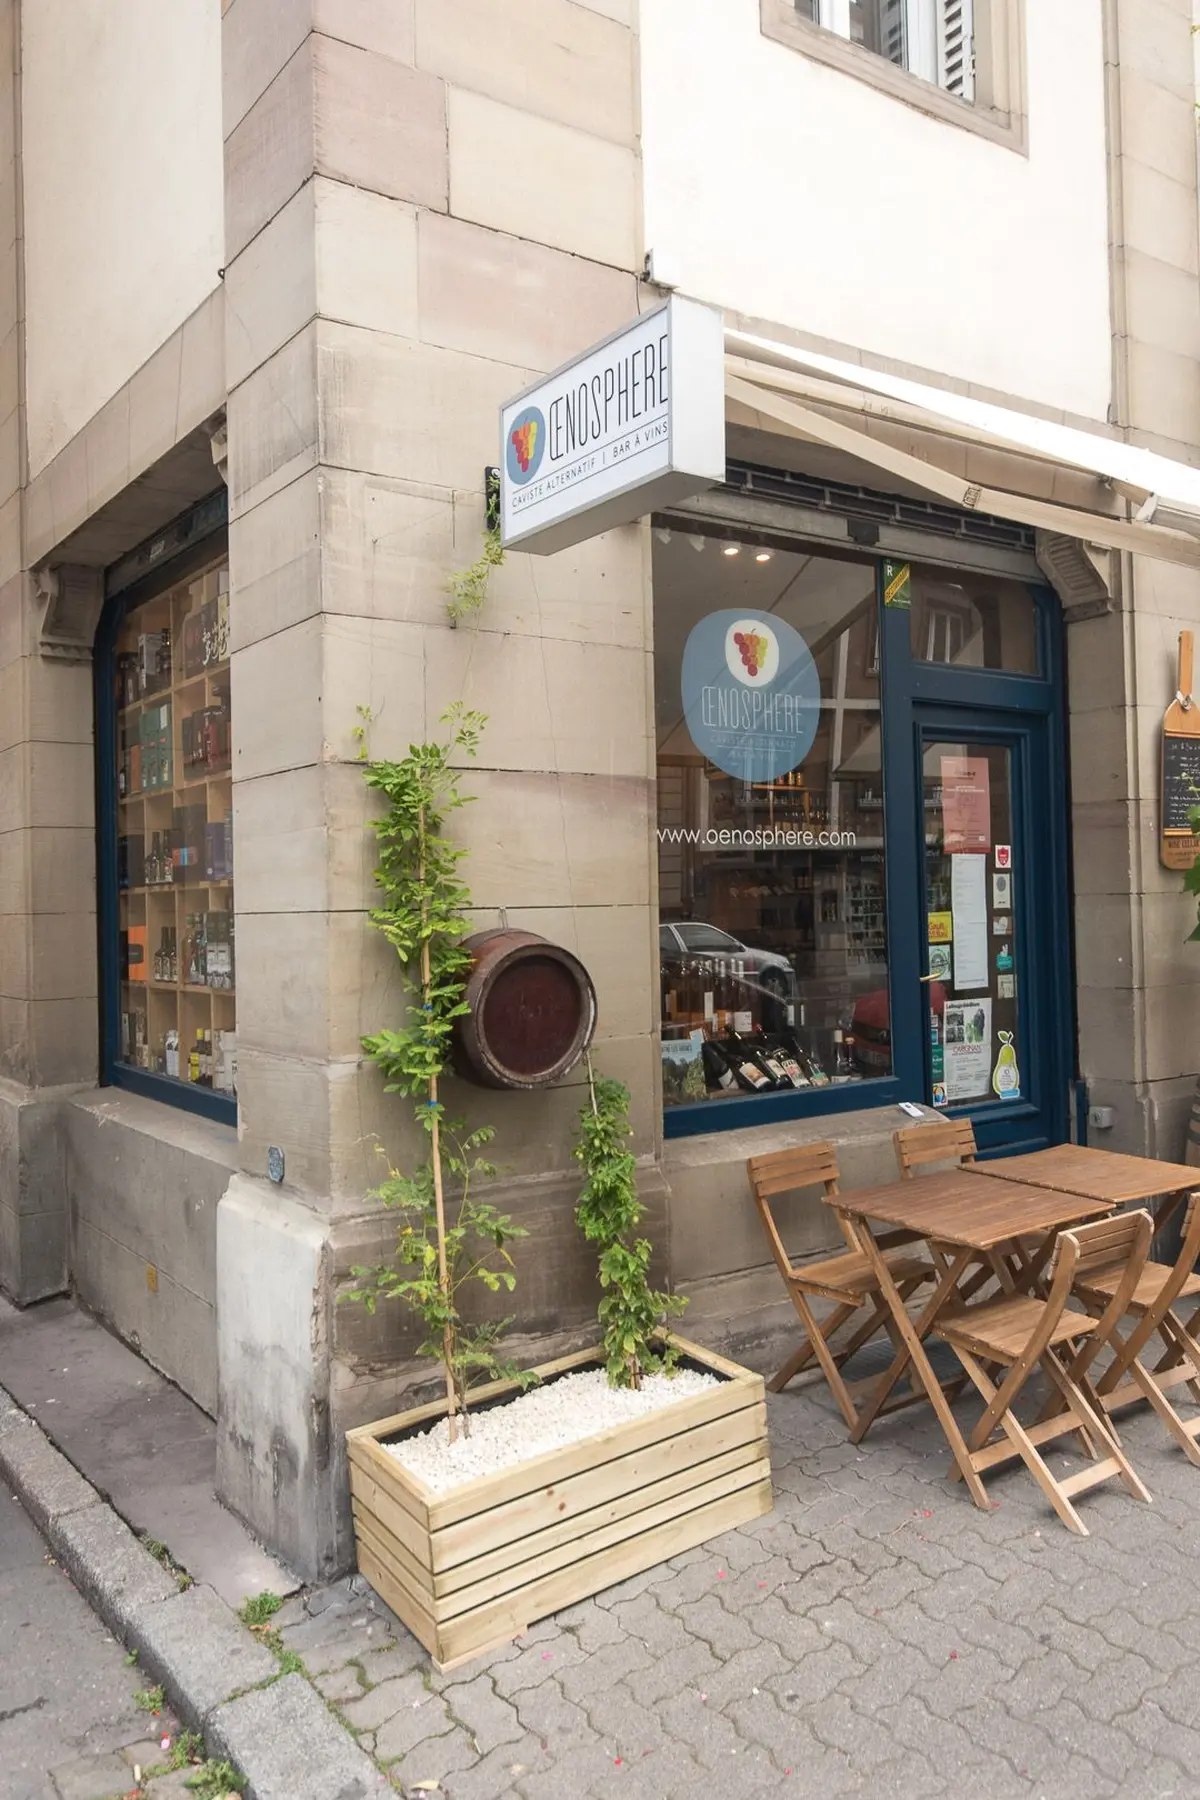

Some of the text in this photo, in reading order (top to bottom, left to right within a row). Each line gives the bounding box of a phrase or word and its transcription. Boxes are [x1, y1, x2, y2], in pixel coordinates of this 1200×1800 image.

[511, 484, 543, 508] CAVISTE
[546, 457, 595, 491] ALTERNATIF
[612, 440, 631, 458] BAR
[644, 421, 668, 442] VINS
